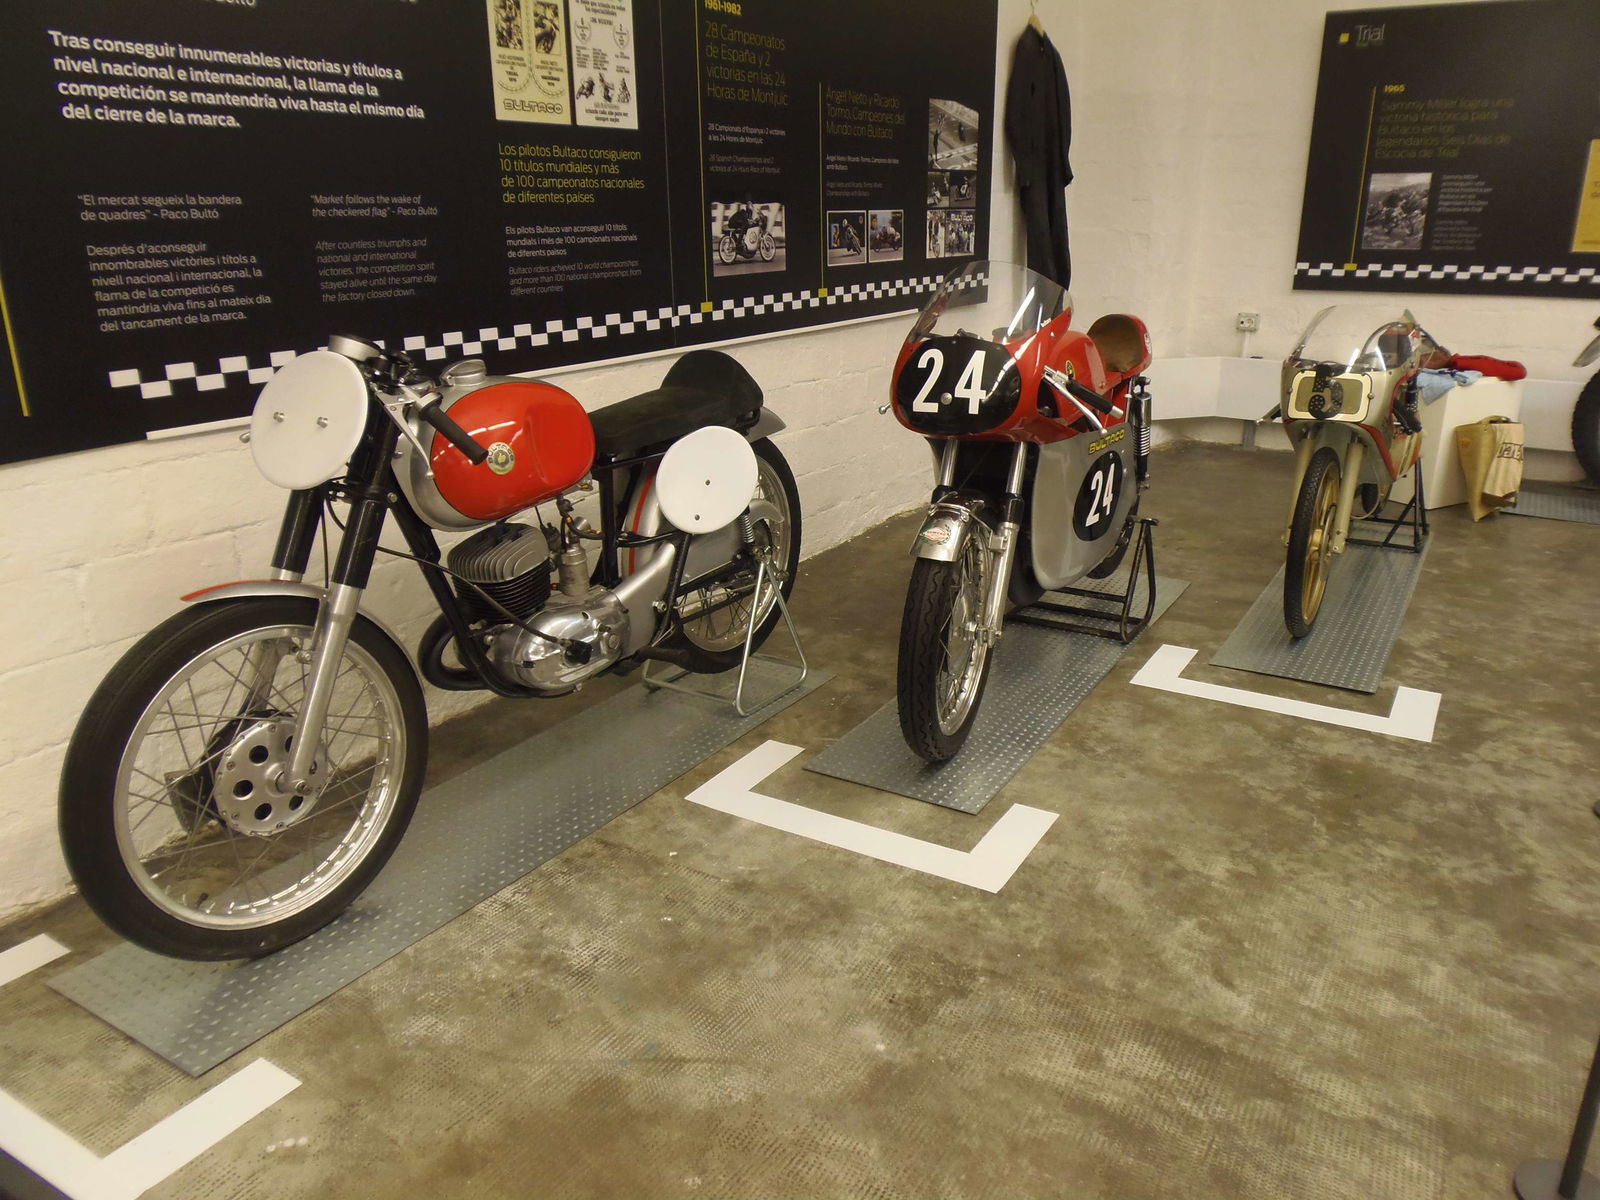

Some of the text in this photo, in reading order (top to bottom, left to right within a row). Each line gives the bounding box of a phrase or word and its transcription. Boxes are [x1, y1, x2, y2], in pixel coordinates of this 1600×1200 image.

[1355, 24, 1386, 41] Trial
[48, 30, 90, 50] Tras
[93, 38, 175, 59] conseguir
[178, 44, 281, 69] innumerables
[283, 55, 341, 74] victorias
[352, 62, 392, 78] títulos
[53, 56, 379, 96] nivel nacional e internacional, la llama de la
[58, 82, 425, 118] competición se mantendría viva hasta el mismo día
[503, 98, 563, 114] BULTACO
[62, 104, 241, 127] del cierre de la marca.
[498, 143, 641, 162] Los pilotos Bultaco consiguieron
[500, 159, 512, 171] 10
[513, 159, 544, 172] títulos
[545, 161, 592, 173] mundiales
[600, 162, 619, 174] más
[501, 175, 645, 190] de 100 campeonatos nacionales
[97, 195, 139, 205] mercat
[141, 194, 184, 207] segueix
[185, 194, 196, 205] la
[197, 194, 242, 204] bandera
[503, 191, 594, 205] de diferentes países
[81, 209, 96, 220] de
[160, 208, 188, 219] Paco
[190, 208, 219, 219] Bultó
[87, 241, 207, 258] Després d'aconseguir
[89, 258, 168, 271] innombrables
[170, 256, 215, 267] victòries
[222, 254, 248, 265] títols
[92, 274, 123, 286] nivell
[125, 271, 174, 284] nacional
[252, 268, 262, 277] la
[95, 284, 234, 301] flama de la competició es
[162, 301, 184, 312] viva
[186, 300, 206, 310] fins
[207, 298, 217, 309] al
[219, 296, 254, 308] mateix
[100, 319, 118, 332] del
[120, 314, 182, 330] tancament
[184, 314, 198, 325] de
[199, 313, 210, 324] la
[912, 348, 987, 414] 24
[1088, 429, 1125, 455] BULTACO
[1085, 463, 1116, 527] 24
